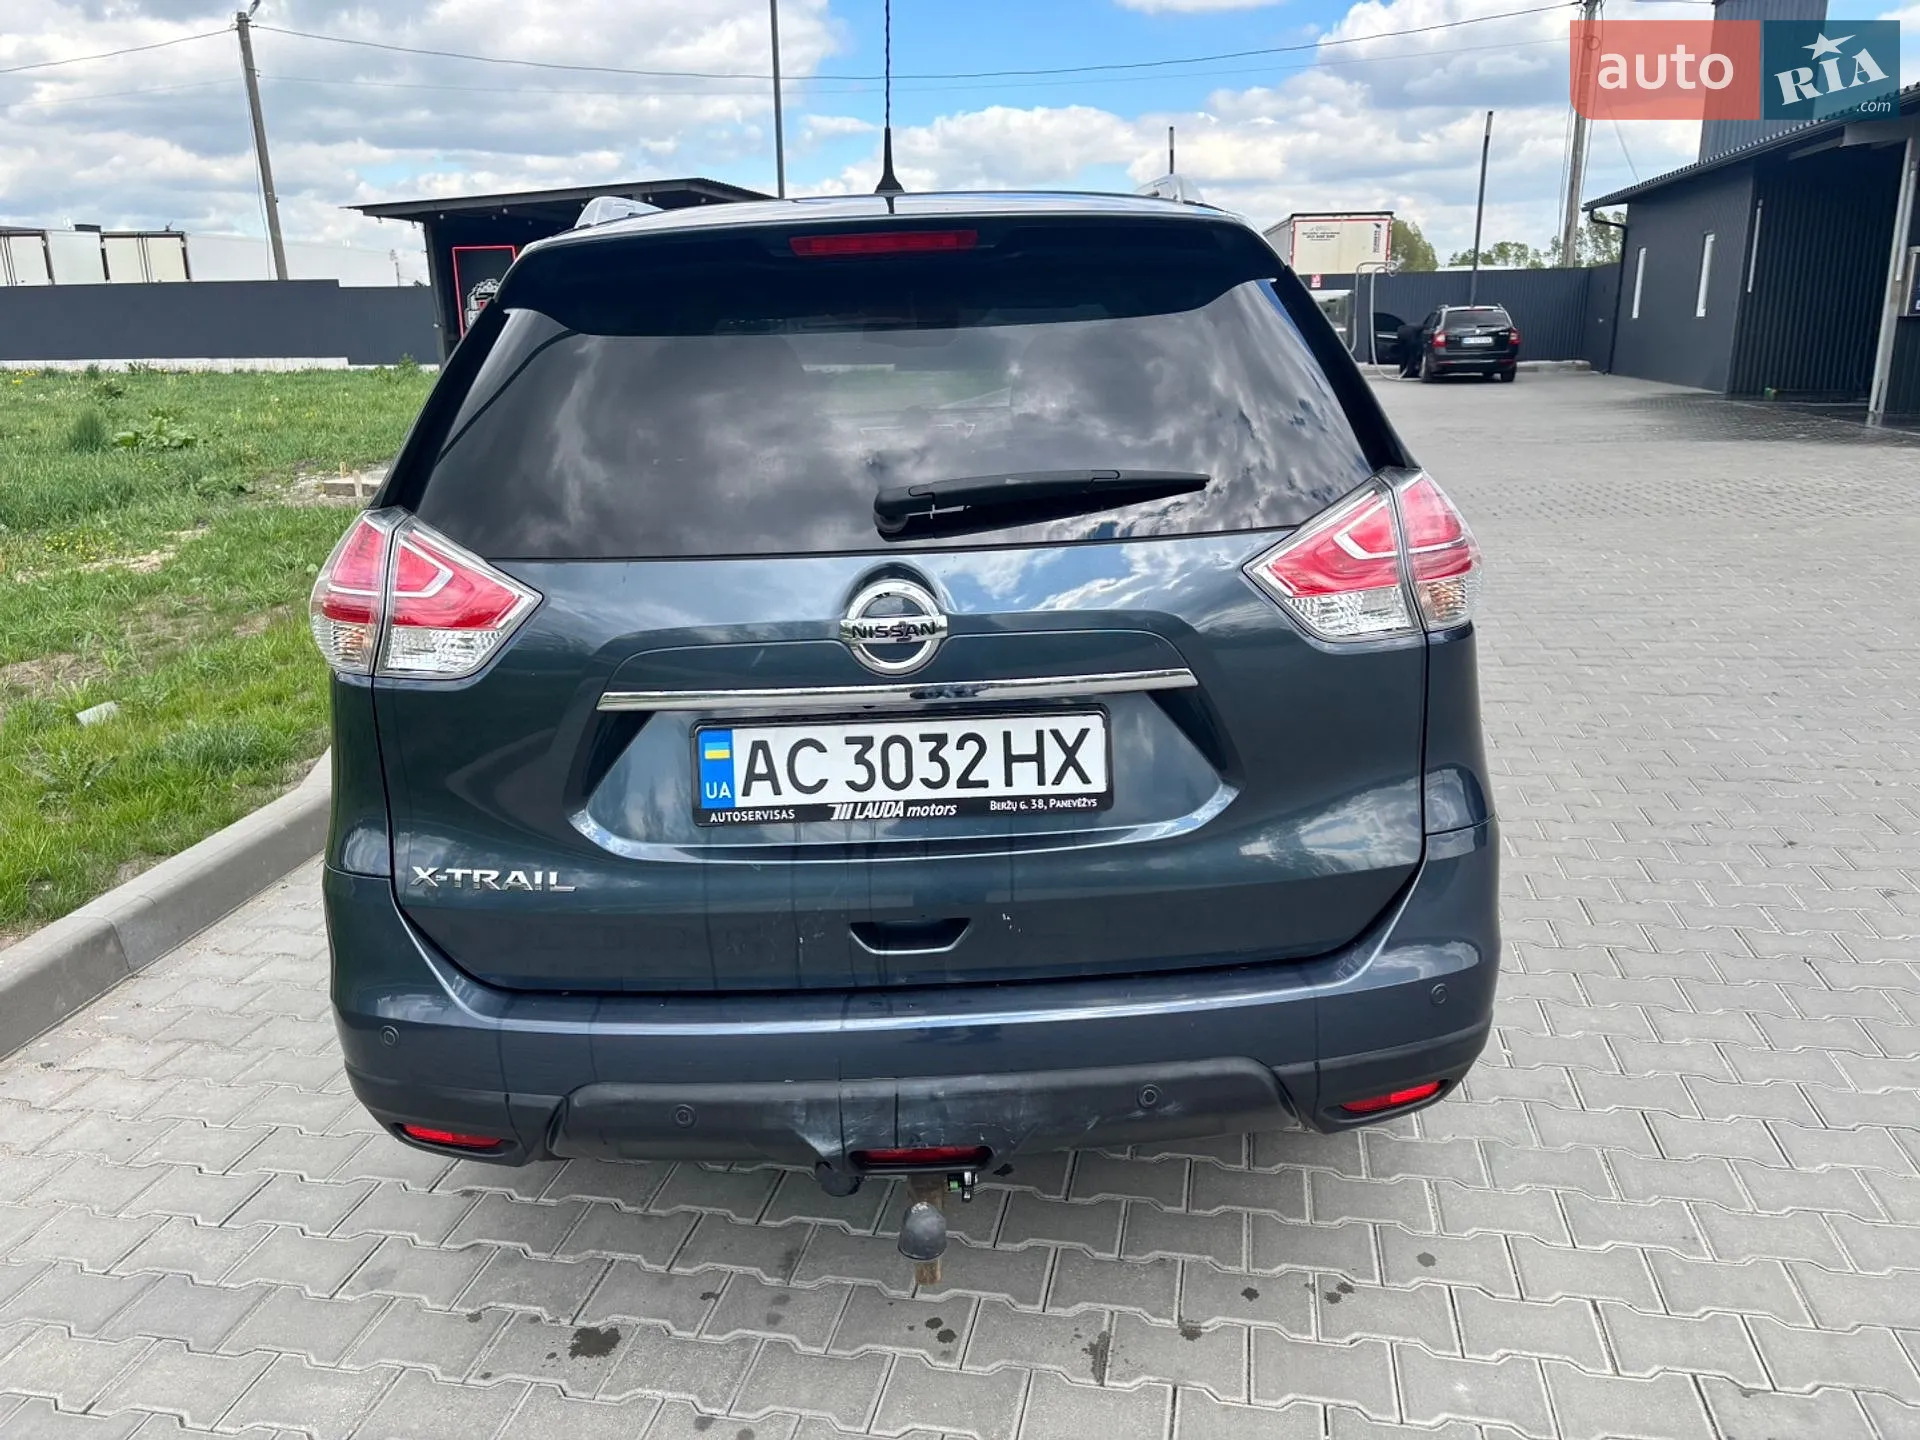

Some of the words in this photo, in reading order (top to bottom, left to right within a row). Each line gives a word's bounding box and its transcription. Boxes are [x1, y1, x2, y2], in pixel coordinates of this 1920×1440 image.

[851, 621, 936, 639] NISSAN
[741, 737, 829, 797] AC
[844, 732, 989, 791] 3032
[1003, 728, 1092, 787] HX
[705, 781, 732, 800] UA
[854, 801, 905, 820] LAUDA
[906, 803, 958, 818] motors
[1030, 799, 1048, 810] 38,
[710, 809, 796, 823] AUTOSERVISAS
[410, 866, 576, 892] X-TRAIL
